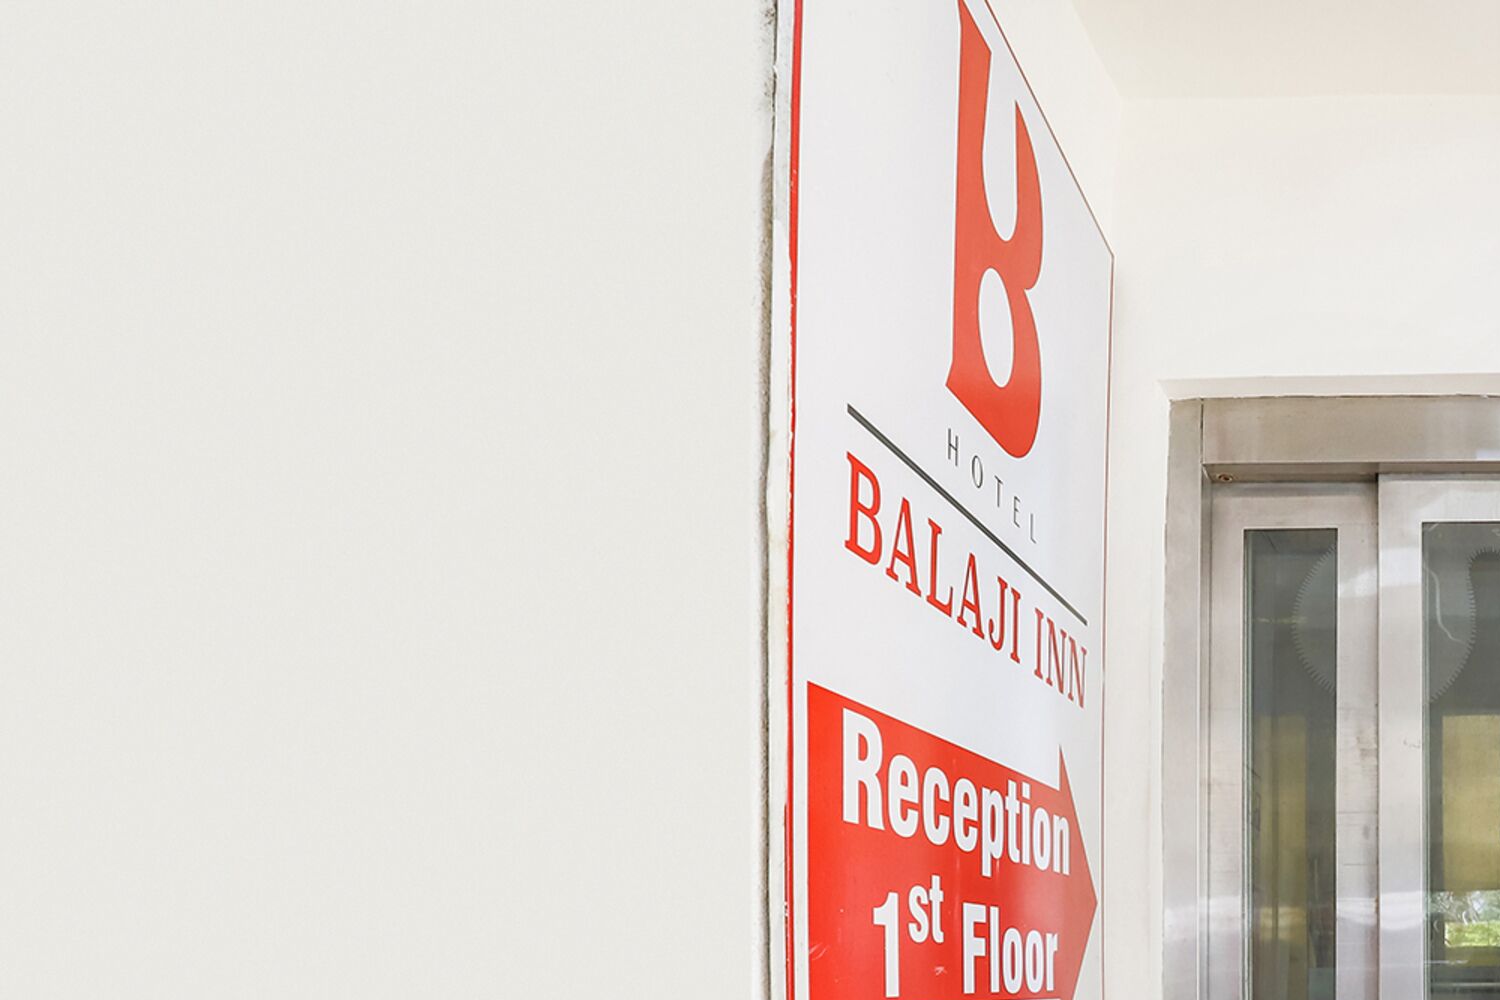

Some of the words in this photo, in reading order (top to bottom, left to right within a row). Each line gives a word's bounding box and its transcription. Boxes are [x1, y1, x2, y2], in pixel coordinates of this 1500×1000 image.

[946, 0, 1043, 459] B
[947, 428, 1037, 544] HOTEL
[844, 451, 1021, 664] BALAJI
[1034, 607, 1087, 708] INN
[842, 706, 1070, 878] Reception
[872, 875, 944, 998] 1st
[962, 901, 1058, 995] Floor
